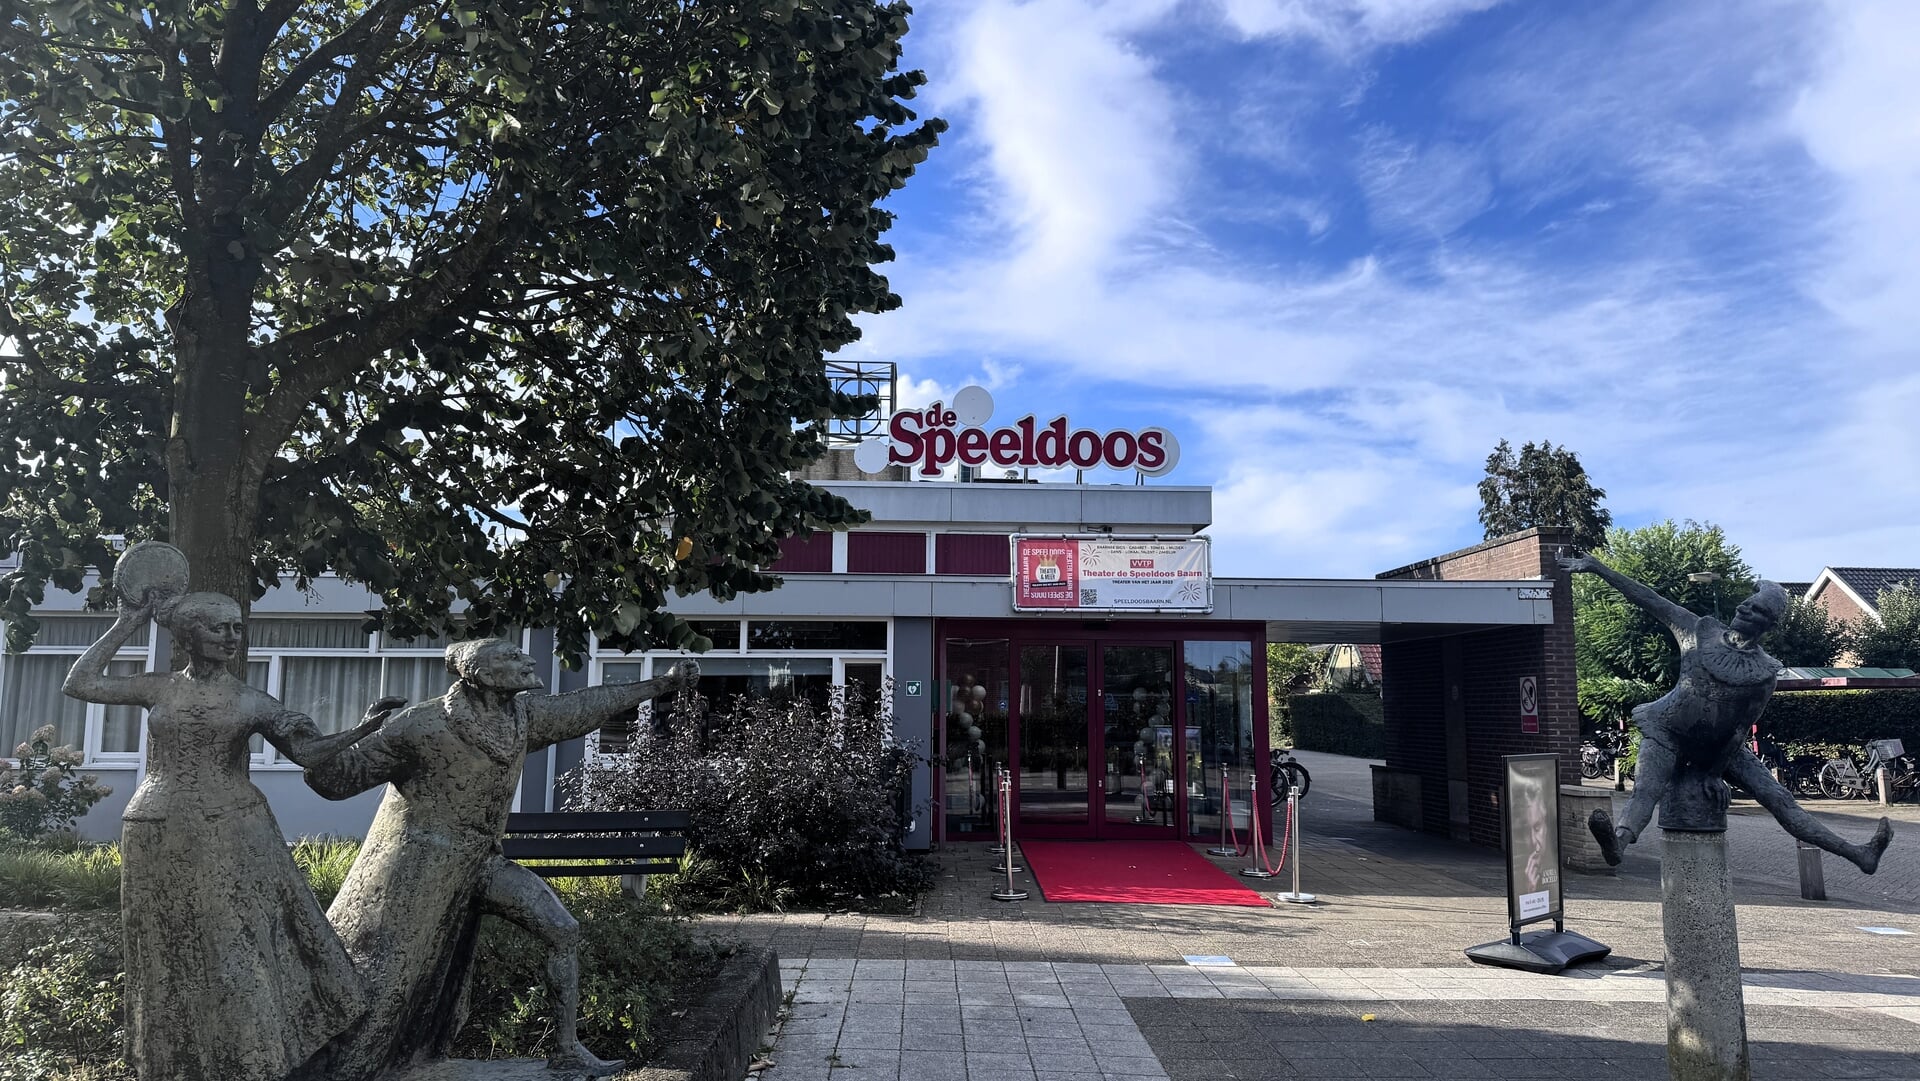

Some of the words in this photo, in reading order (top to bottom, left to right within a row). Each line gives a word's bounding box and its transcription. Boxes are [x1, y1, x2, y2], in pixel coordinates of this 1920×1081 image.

[925, 403, 956, 427] de
[889, 411, 1165, 475] Speeldoos
[1130, 570, 1175, 579] Speeldoos
